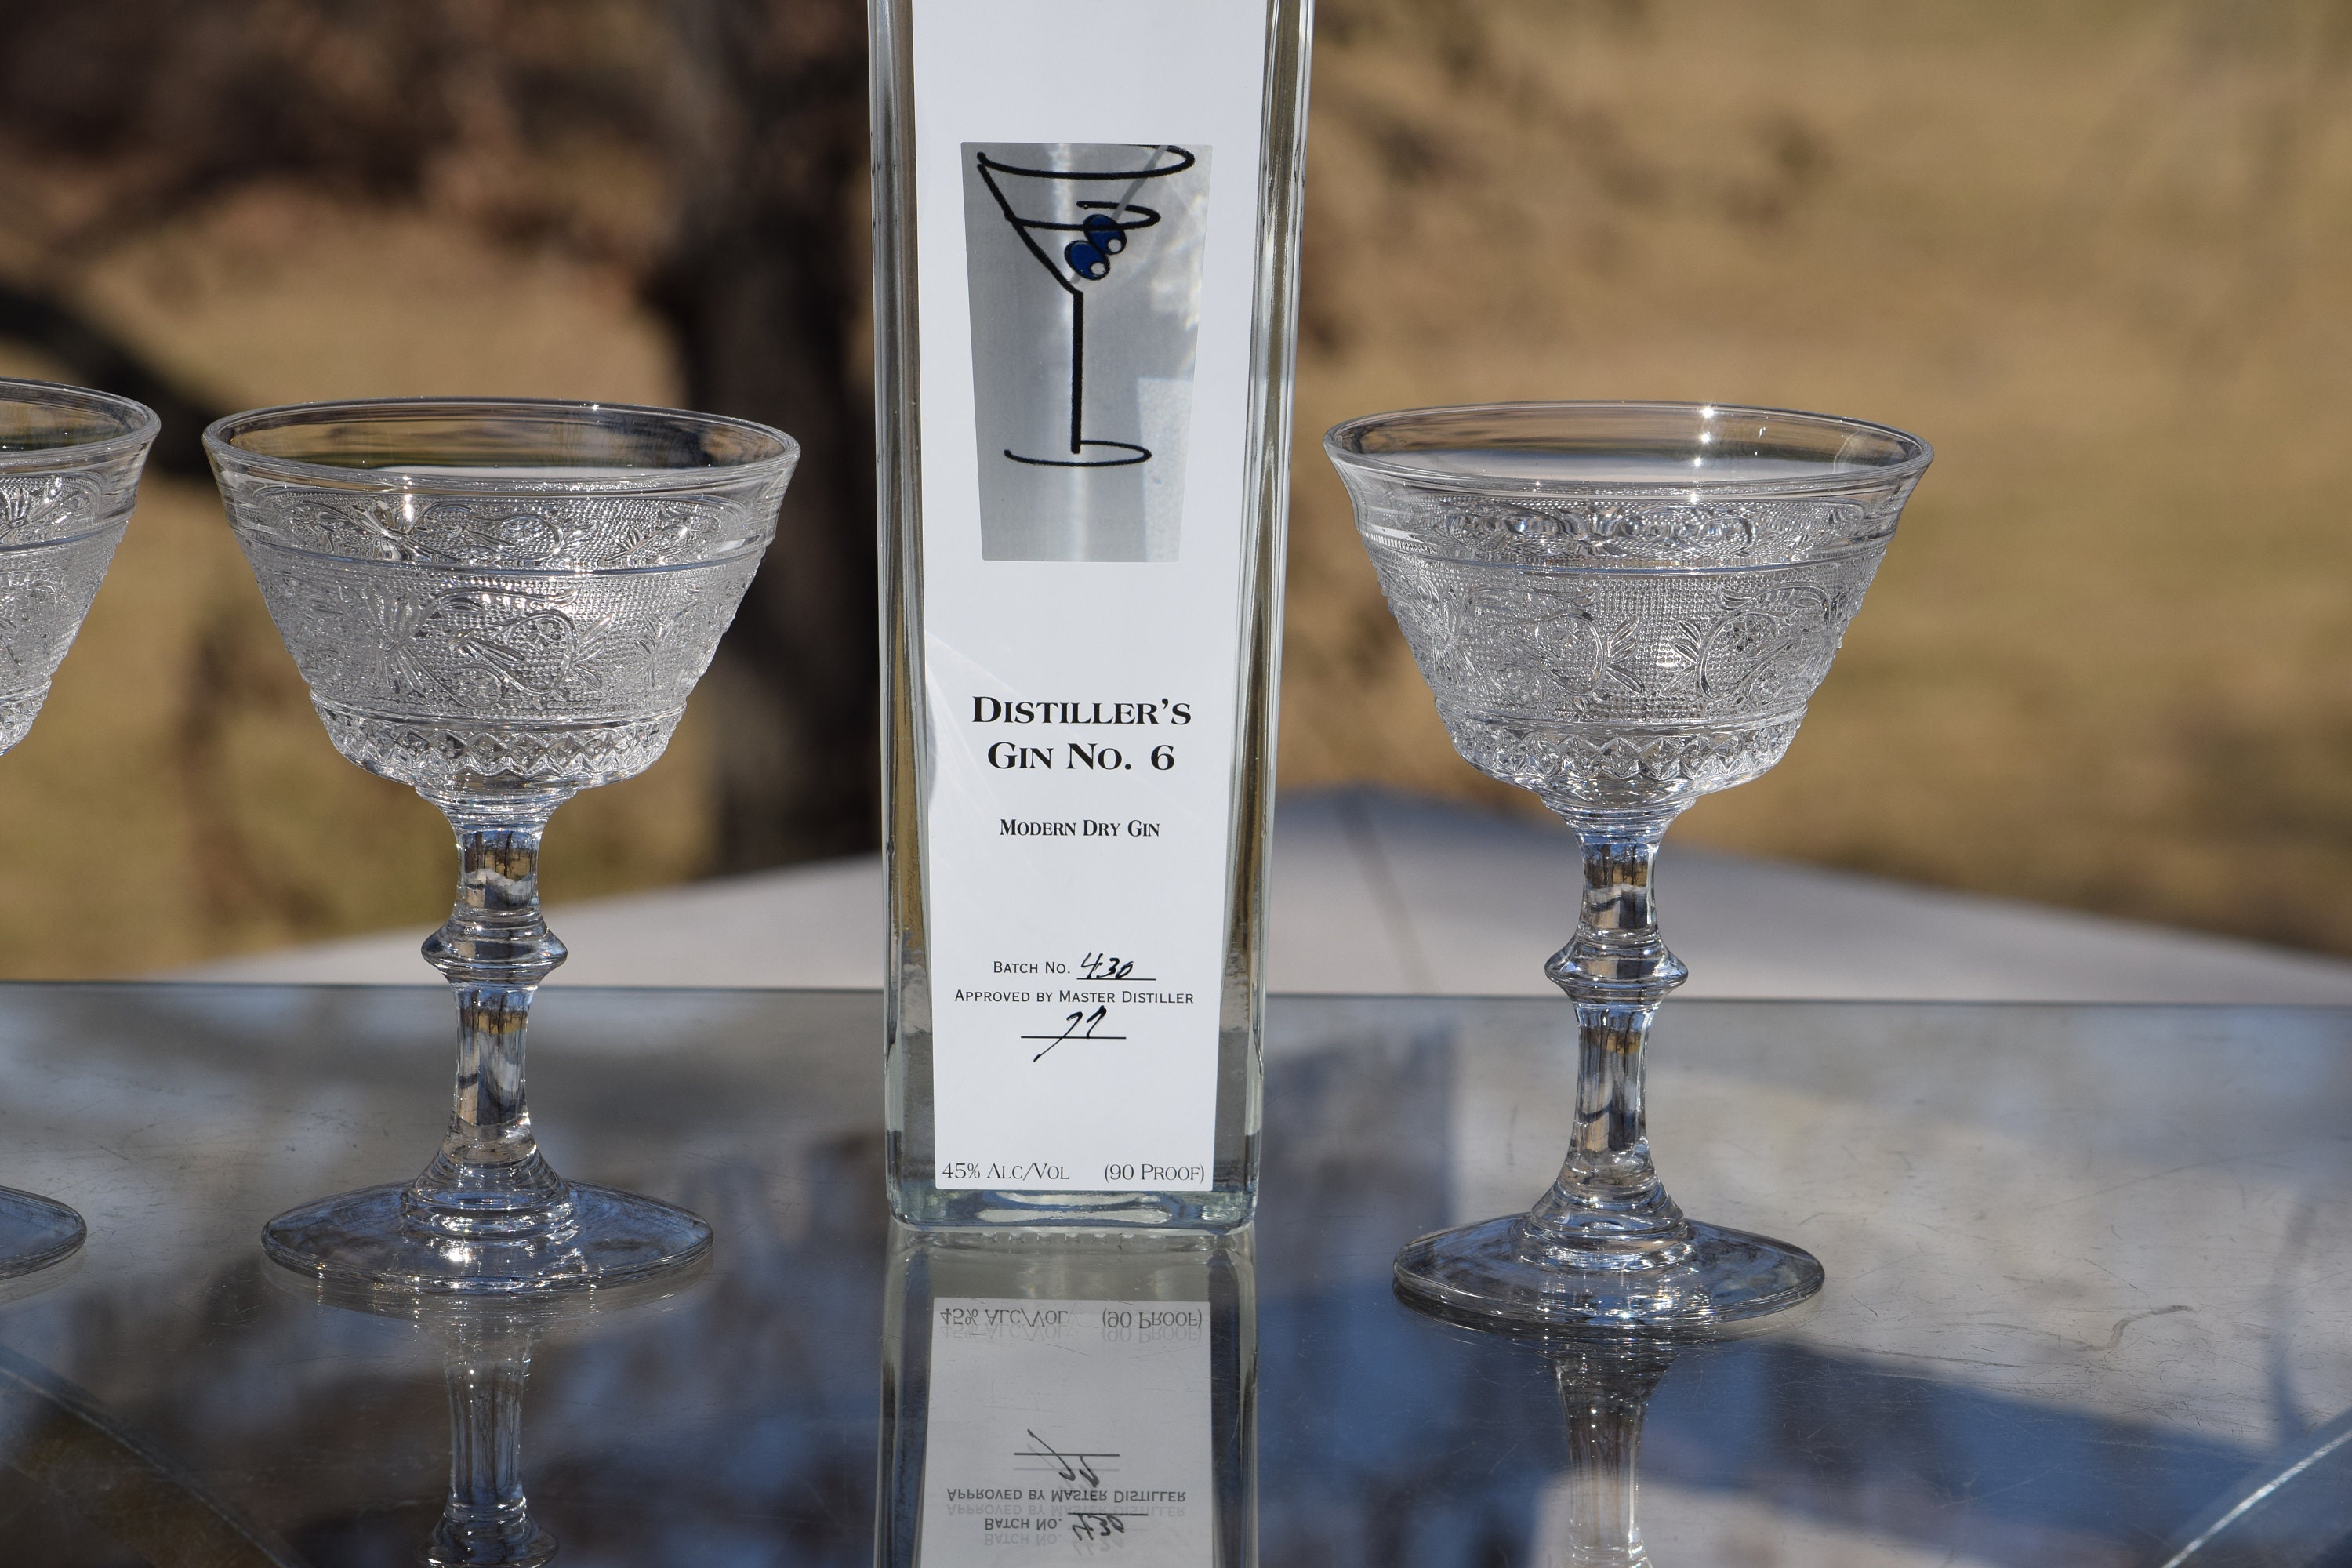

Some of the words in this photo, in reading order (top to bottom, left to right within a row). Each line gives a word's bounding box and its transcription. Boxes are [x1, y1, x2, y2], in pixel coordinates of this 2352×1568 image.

[971, 696, 1192, 725] DISTILLER'S
[987, 741, 1054, 770] GIN
[1065, 742, 1132, 771] NO.
[1150, 744, 1175, 771] 6
[1000, 818, 1076, 837] MODERN
[1083, 819, 1121, 837] DRY
[1127, 819, 1160, 837] GIN
[993, 960, 1038, 974] BATCH
[1045, 961, 1071, 975] NO.
[1080, 952, 1134, 978] 430
[954, 989, 1030, 1003] APPROVED
[1036, 992, 1053, 1003] BY
[1059, 989, 1116, 1004] MASTER
[1122, 990, 1194, 1004] DISTILLER
[942, 1162, 981, 1179] 45%
[986, 1163, 1070, 1181] ALC/VOL
[1104, 1163, 1134, 1183] (90
[1141, 1163, 1205, 1183] PROOF)
